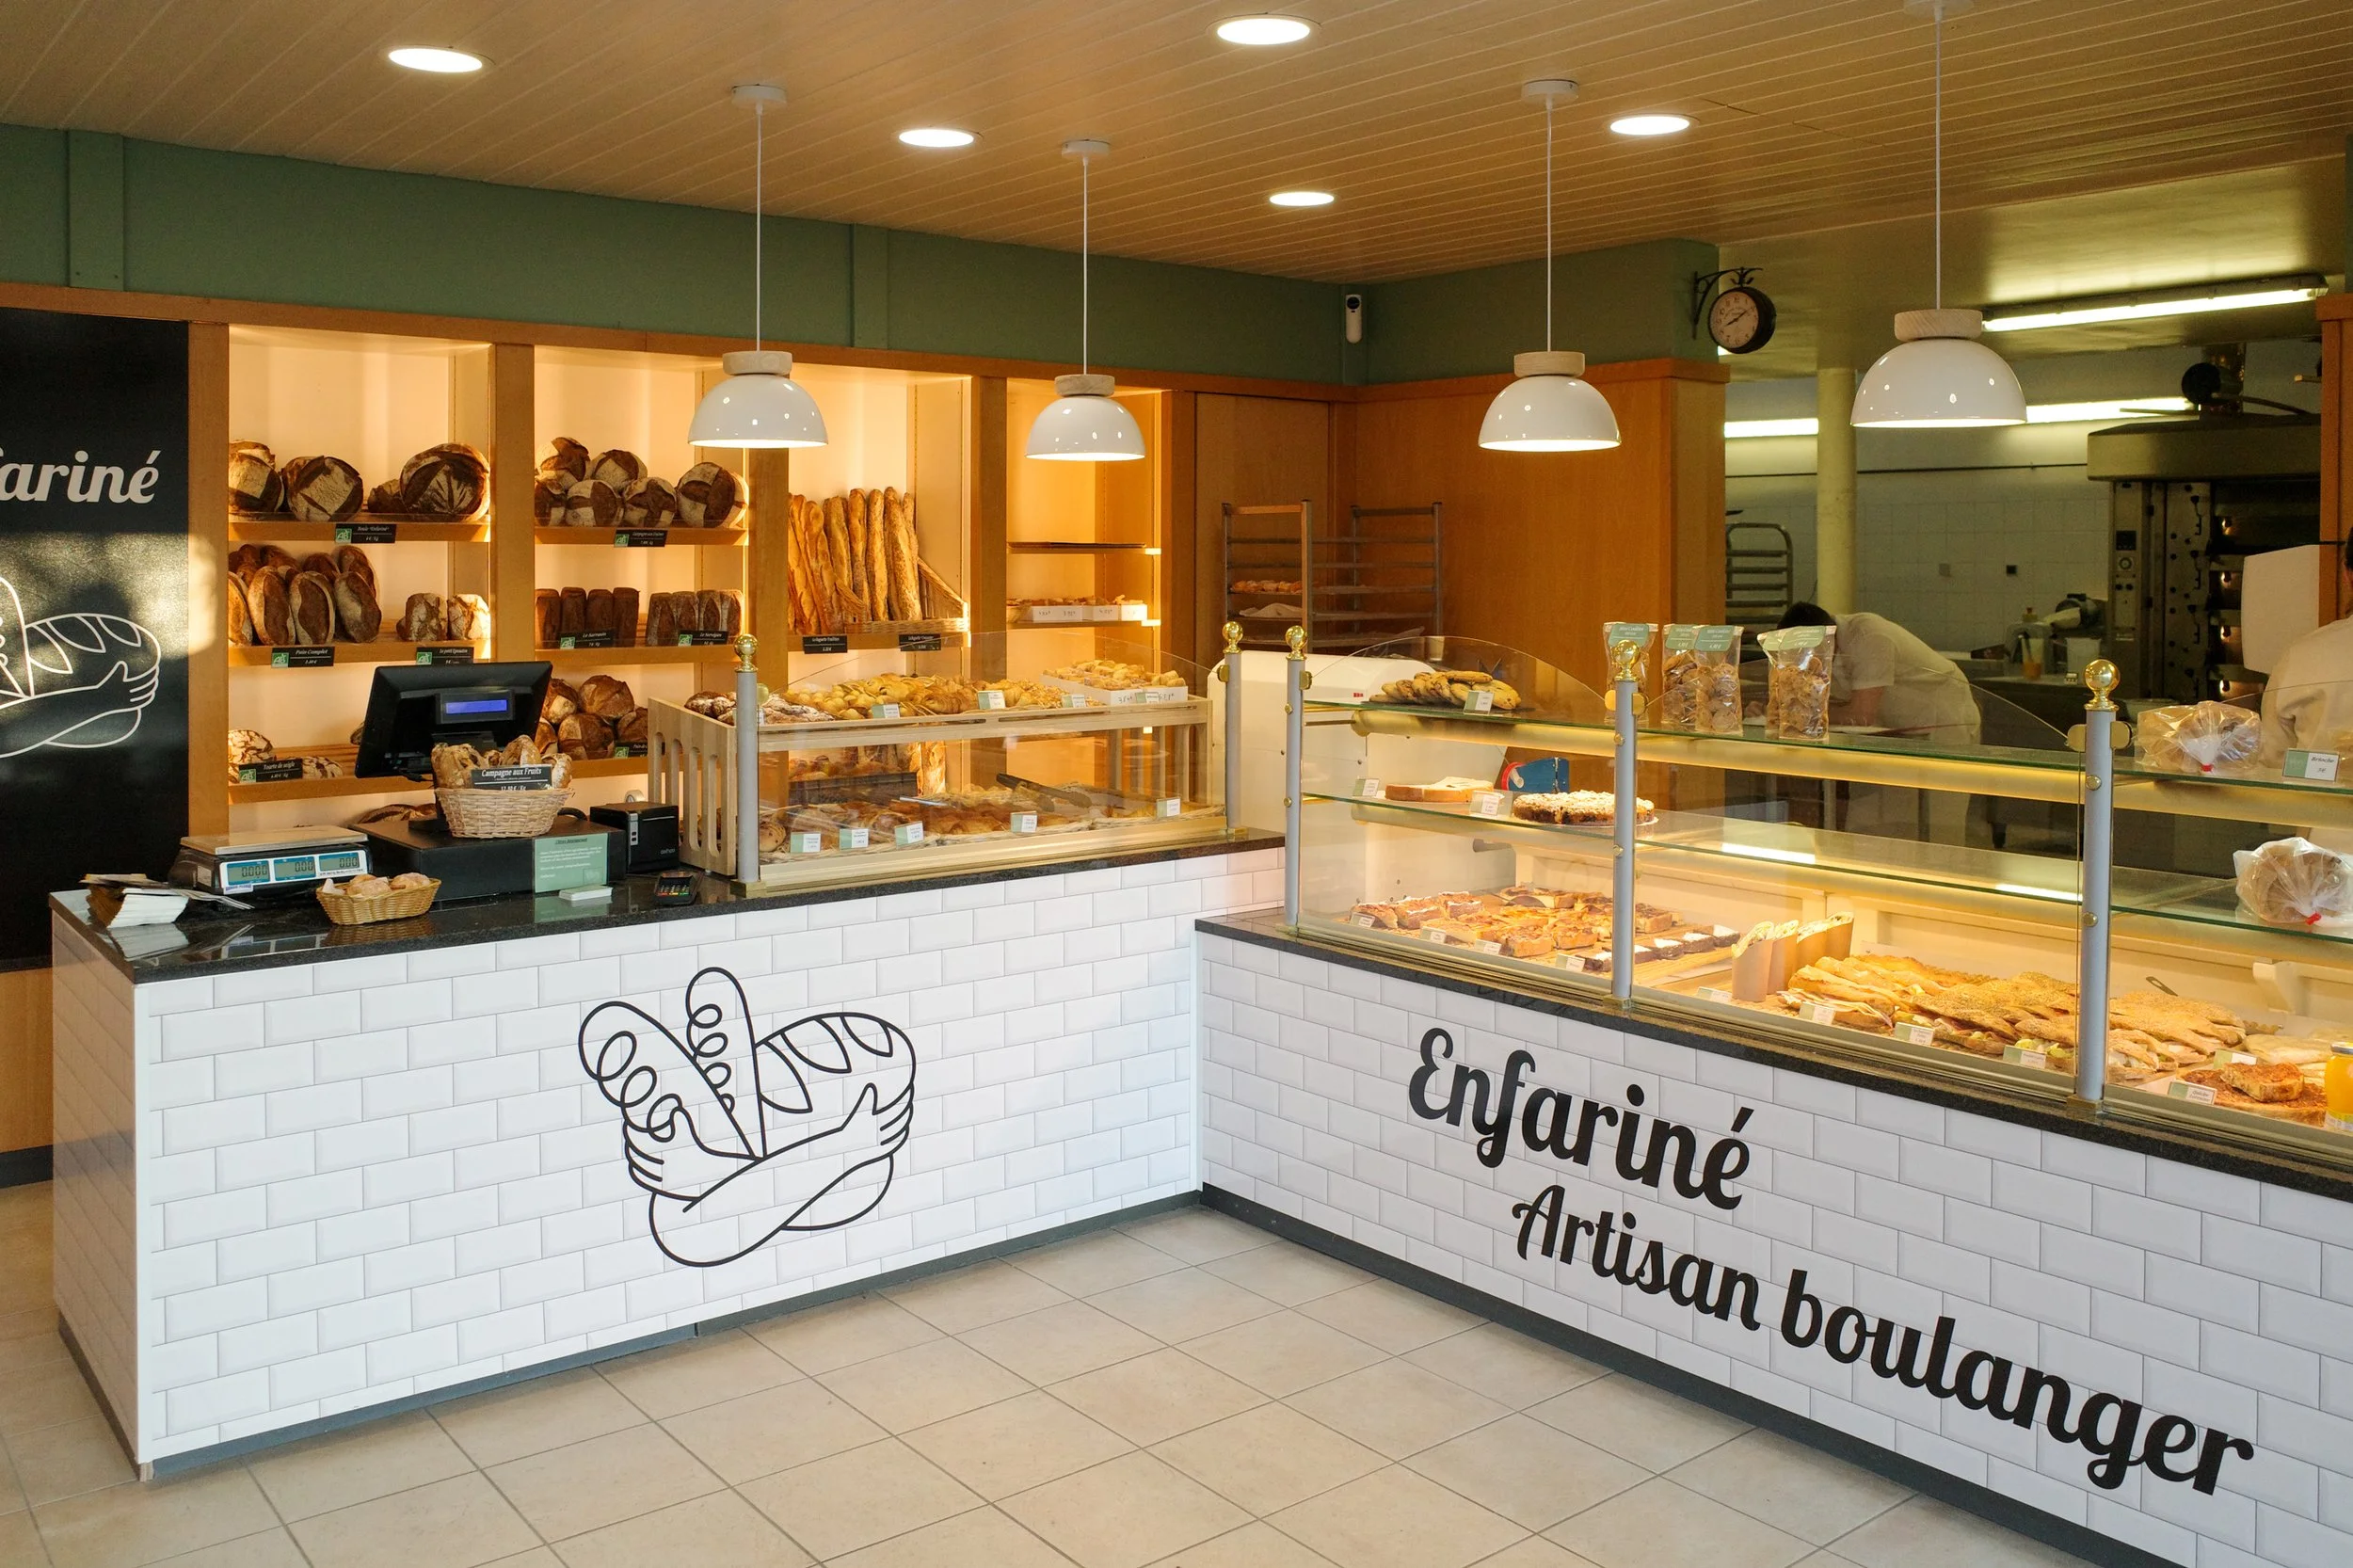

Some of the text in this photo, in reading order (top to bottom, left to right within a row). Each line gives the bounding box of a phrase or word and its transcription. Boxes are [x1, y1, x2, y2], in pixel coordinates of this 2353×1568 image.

[482, 769, 511, 777] Campagne
[1409, 1028, 1754, 1209] Enfariné
[1512, 1185, 2254, 1496] Artisan boulanger
